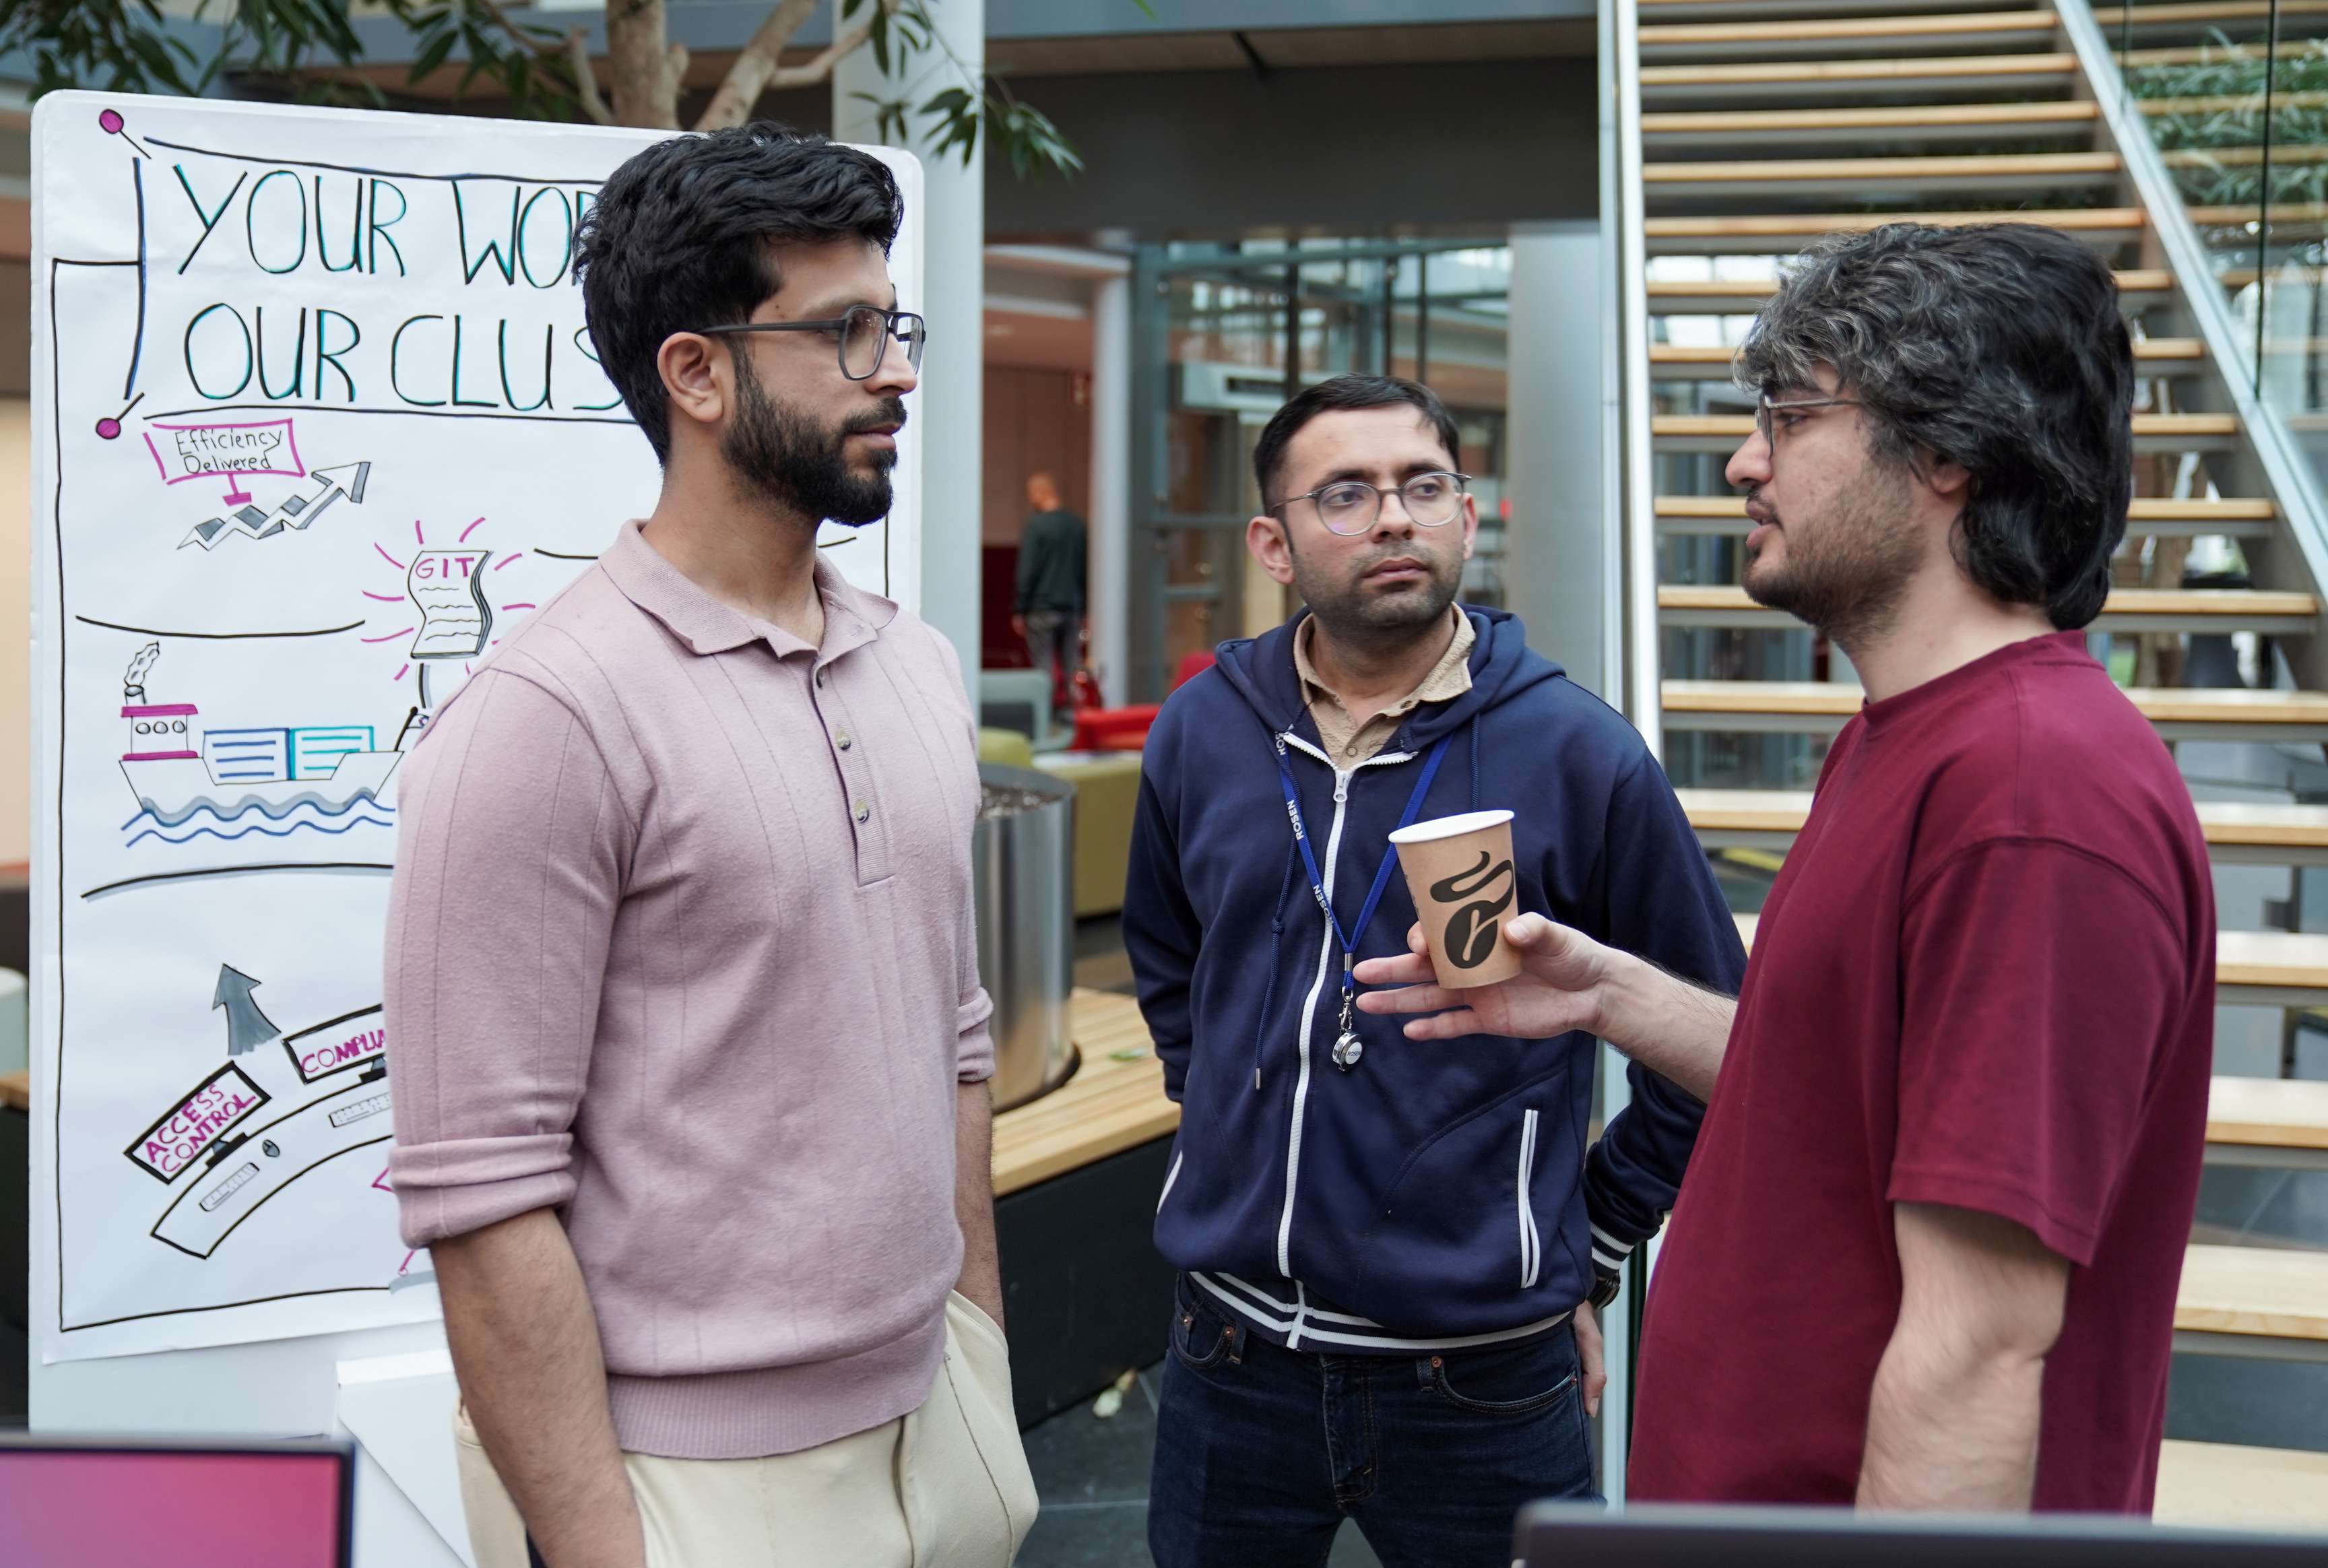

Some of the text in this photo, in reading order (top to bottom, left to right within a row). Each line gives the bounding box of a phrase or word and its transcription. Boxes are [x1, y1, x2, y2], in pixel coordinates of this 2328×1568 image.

[172, 164, 407, 277] YOUR
[184, 302, 361, 403] OUR
[174, 427, 283, 456] Efficiency
[183, 453, 272, 474] Delivered
[415, 556, 475, 579] GIT
[1287, 799, 1305, 841] ROSEN
[145, 1082, 224, 1163] ACCESS
[161, 1094, 257, 1173] CONTROL
